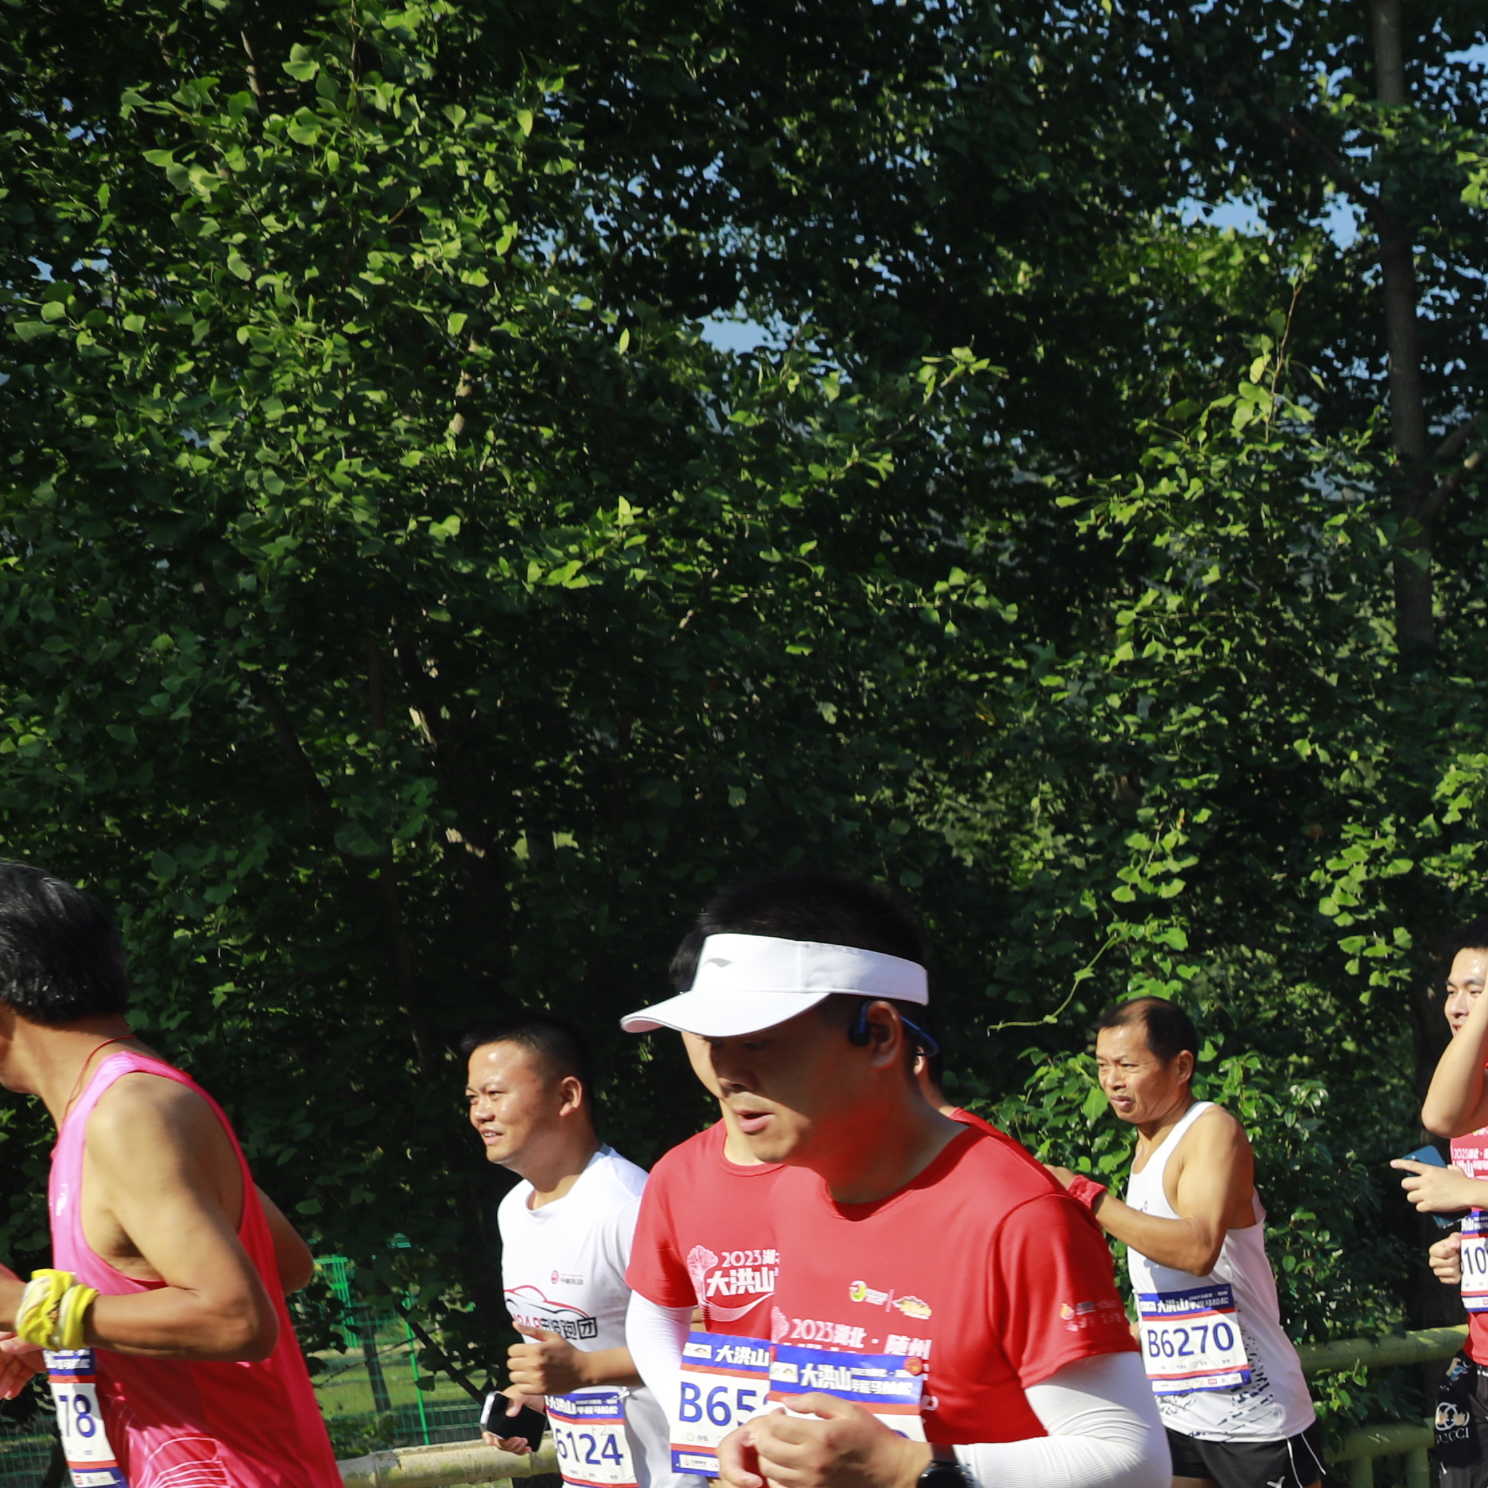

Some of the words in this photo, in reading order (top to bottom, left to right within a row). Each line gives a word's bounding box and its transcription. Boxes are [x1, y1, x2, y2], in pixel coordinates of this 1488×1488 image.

[707, 1267, 775, 1298] 大洪山
[1147, 1322, 1234, 1357] B6270
[714, 1344, 770, 1367] 大洪山
[800, 1363, 851, 1390] 大洪山
[679, 1381, 770, 1427] B65
